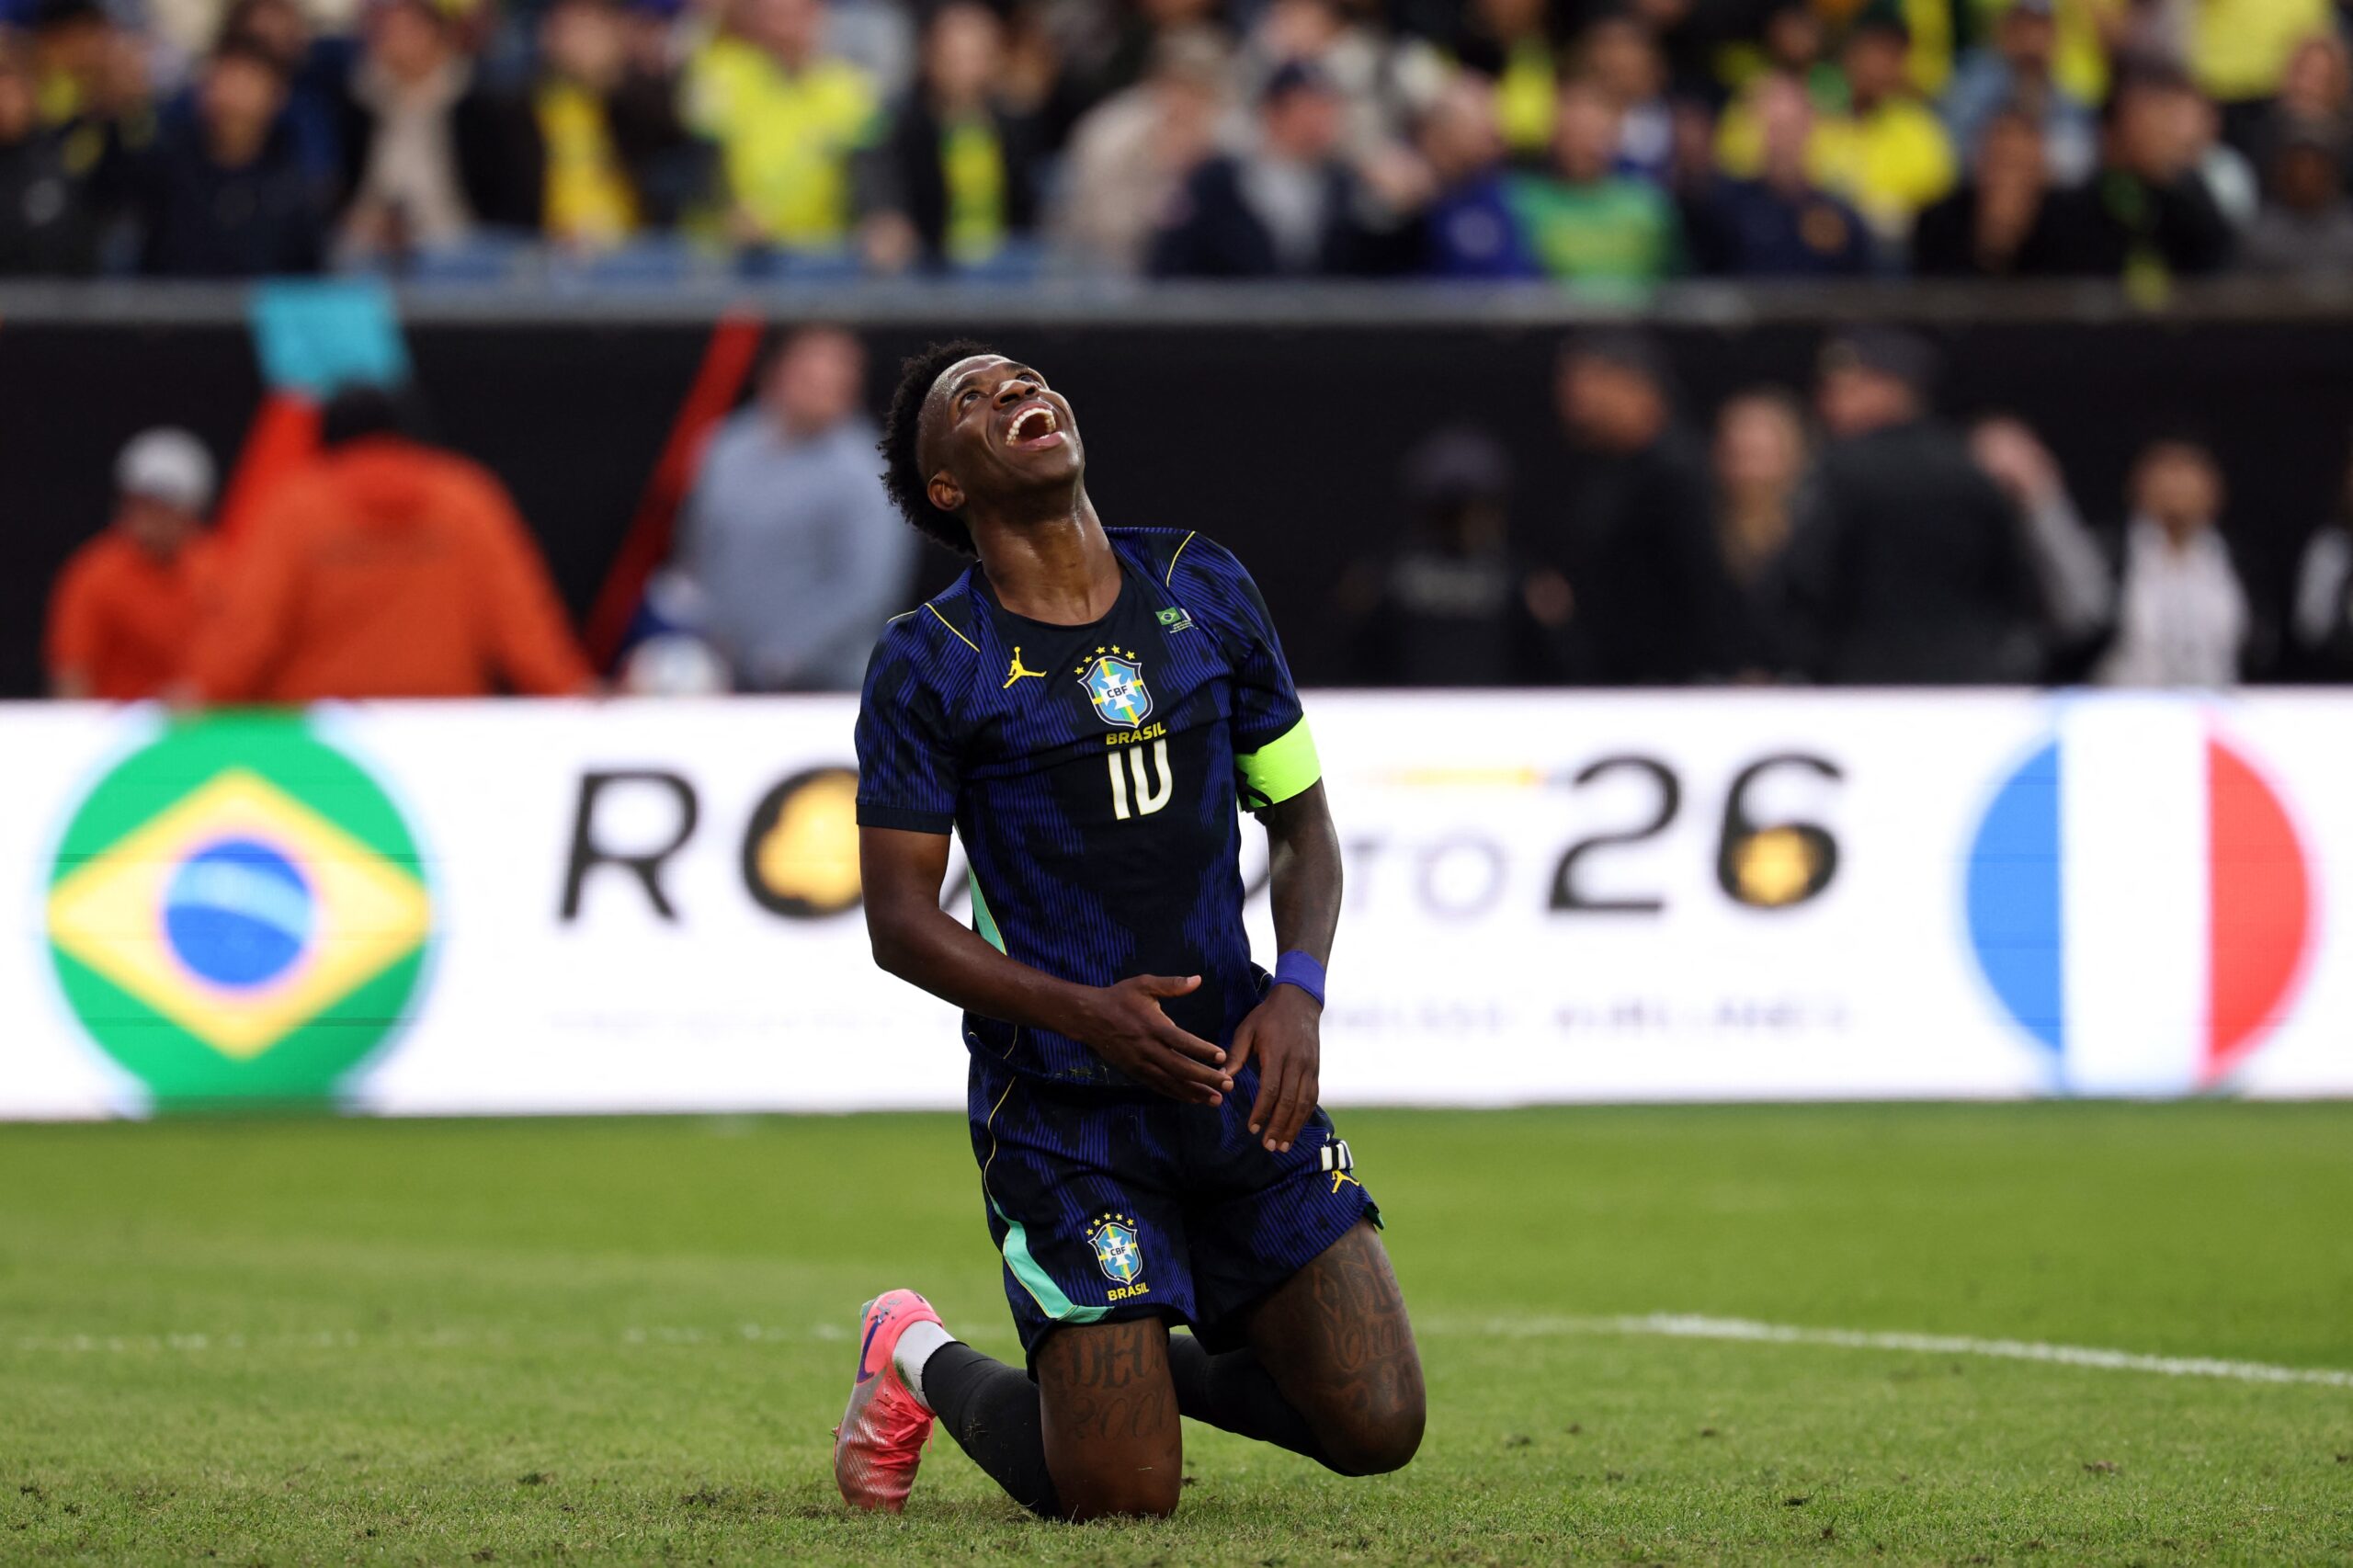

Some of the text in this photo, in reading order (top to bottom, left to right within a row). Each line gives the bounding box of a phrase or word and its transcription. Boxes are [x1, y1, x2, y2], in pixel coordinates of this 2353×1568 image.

[1107, 685, 1128, 699] CBF
[1106, 722, 1166, 745] BRASIL
[1108, 738, 1173, 820] 10
[1548, 754, 1844, 912] 26
[1110, 1246, 1126, 1256] CBF
[1108, 1282, 1150, 1301] BRASIL
